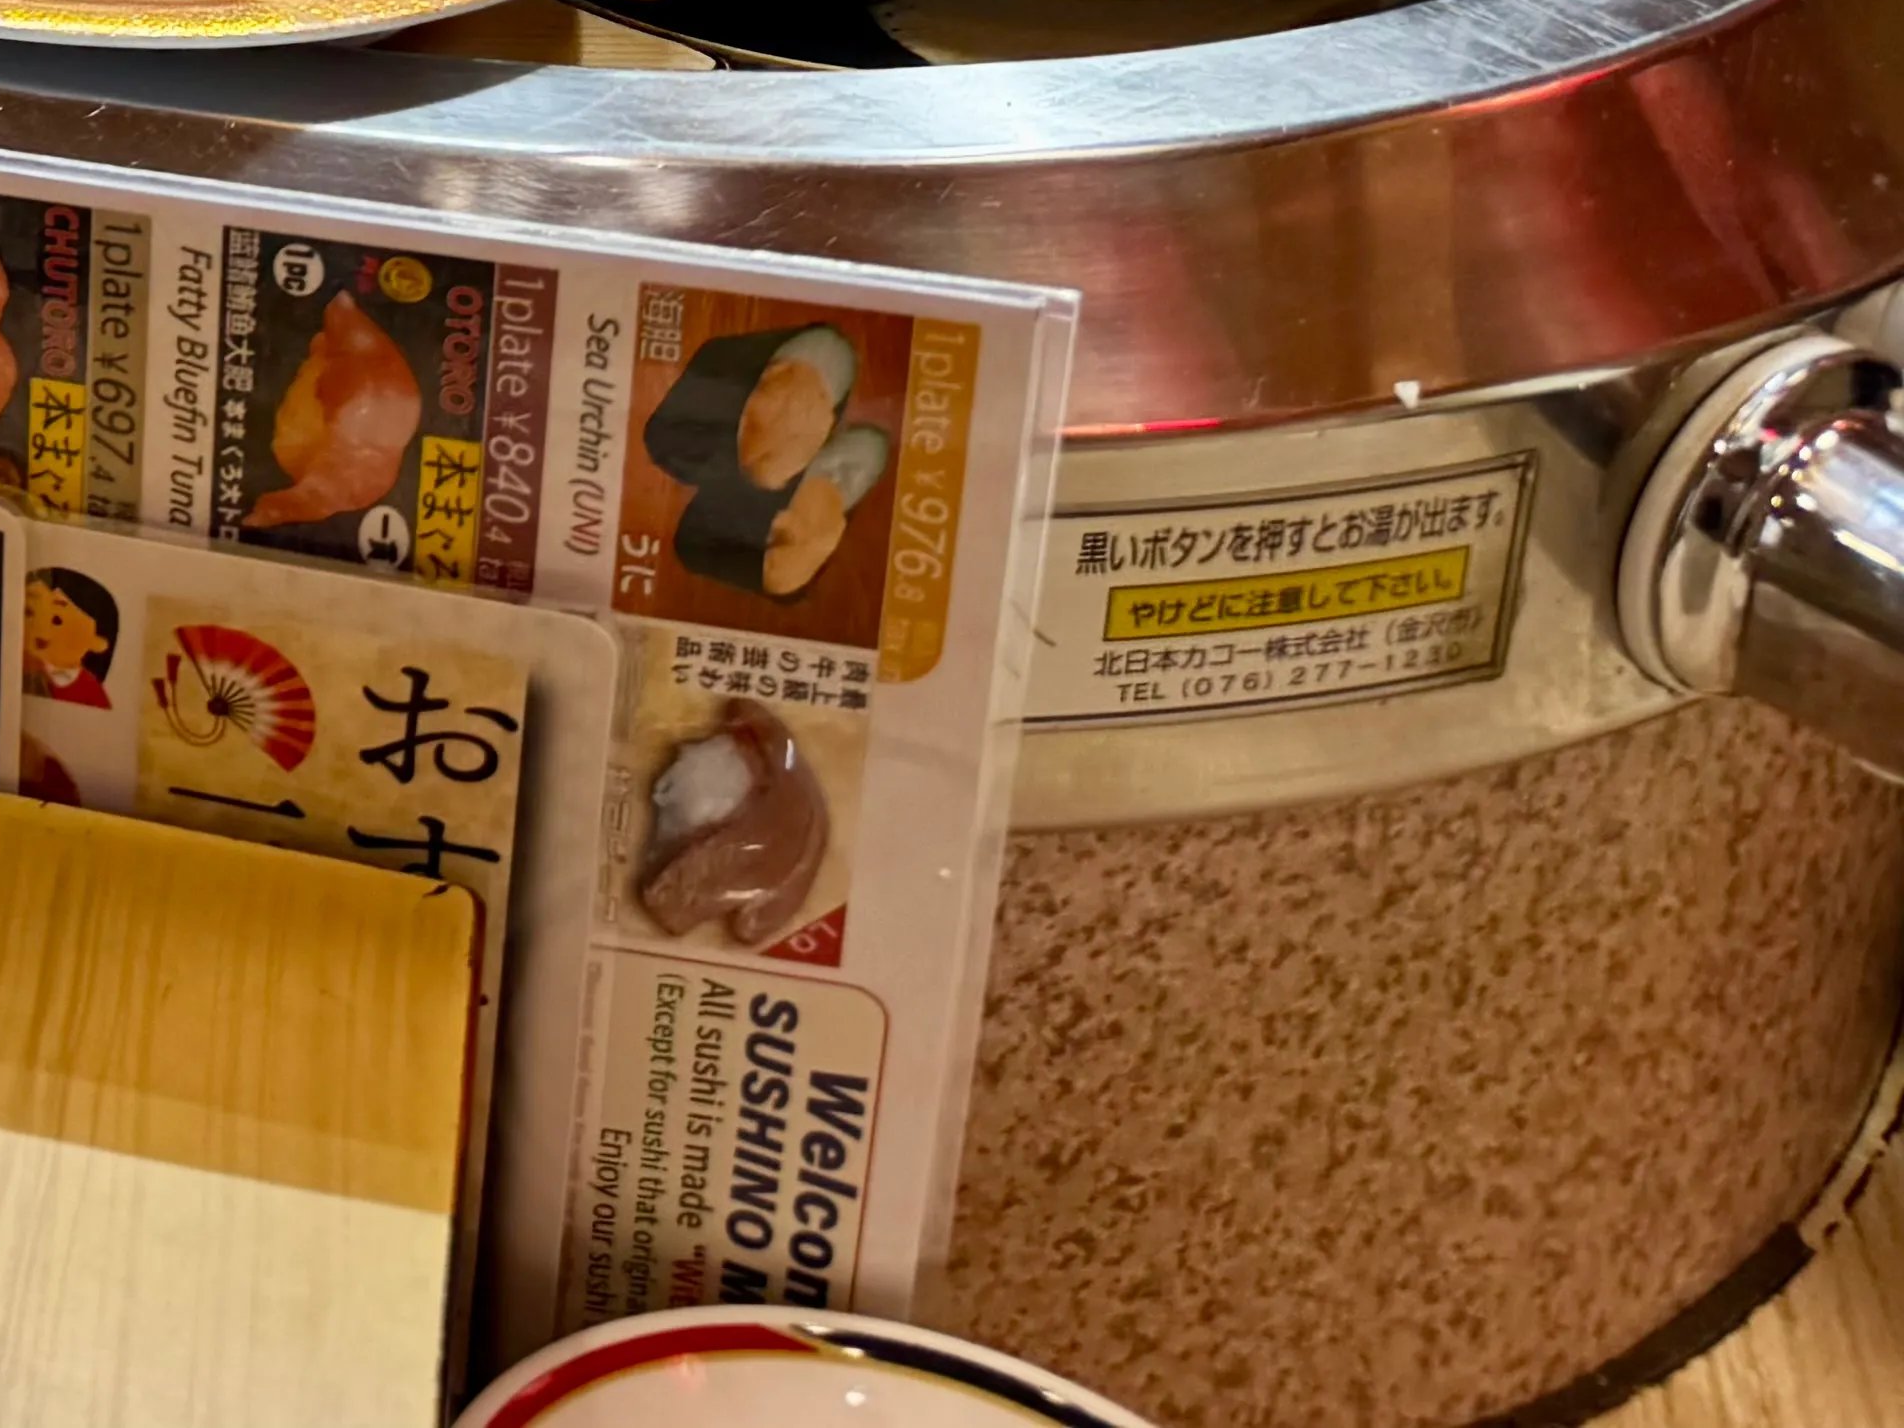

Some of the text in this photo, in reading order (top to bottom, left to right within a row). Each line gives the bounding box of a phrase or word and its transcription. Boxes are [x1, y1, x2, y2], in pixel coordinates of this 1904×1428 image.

[42, 206, 80, 377] CHUTORO
[163, 246, 213, 528] Fatty Bluefin Tuna
[439, 285, 483, 415] OTORO
[563, 312, 620, 557] Sea Urchin (UNI)
[619, 533, 660, 596] うに
[1076, 490, 1505, 575] 黒いボタンを押すとお湯が出ます。
[1128, 573, 1454, 628] やけどに注意して下さい。
[1117, 679, 1166, 702] TEL
[1181, 670, 1274, 699] (076)
[697, 977, 736, 1020] All
[636, 973, 686, 1226] (Except for sushi that
[691, 1025, 728, 1107] sushi
[725, 992, 800, 1251] SUSHINO
[588, 1127, 632, 1246] Enjoy our
[677, 1143, 715, 1230] made
